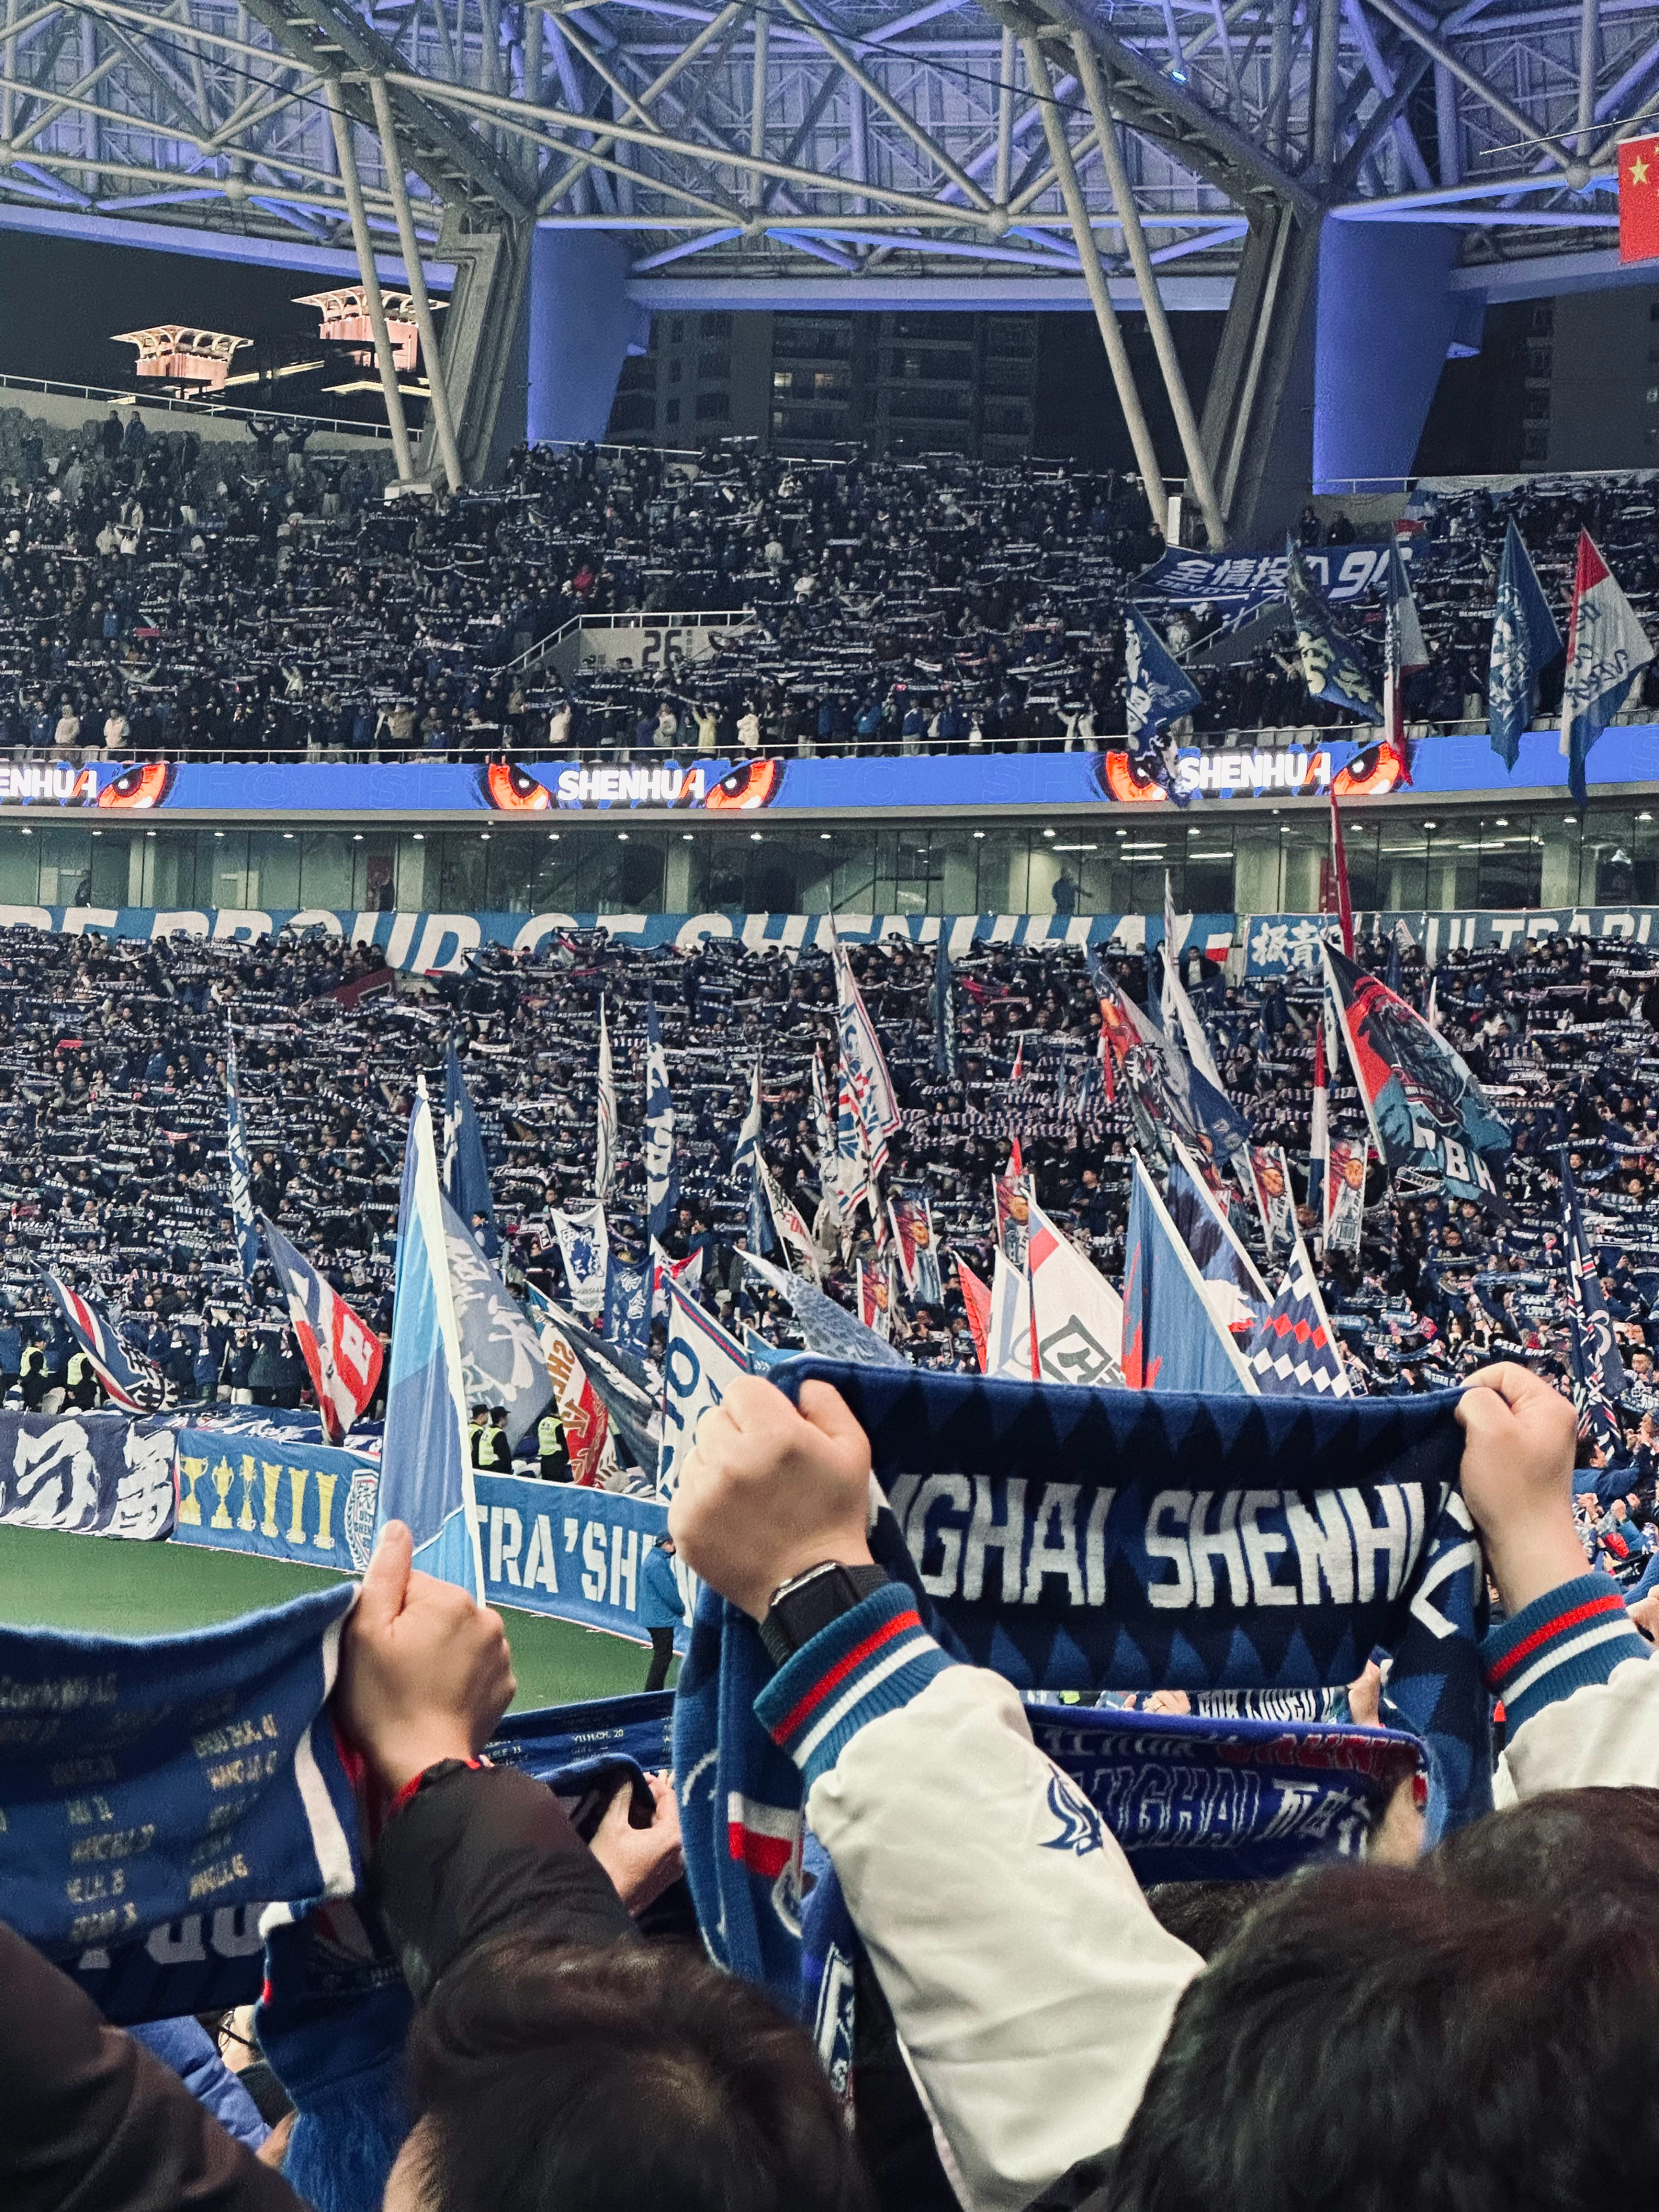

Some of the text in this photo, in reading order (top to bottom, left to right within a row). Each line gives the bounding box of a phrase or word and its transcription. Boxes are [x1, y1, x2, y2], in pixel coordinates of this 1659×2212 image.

[1164, 556, 1329, 588] 全情投
[642, 630, 684, 668] 26
[557, 769, 705, 800] SHENHUA
[1180, 752, 1331, 790] SHENHUA
